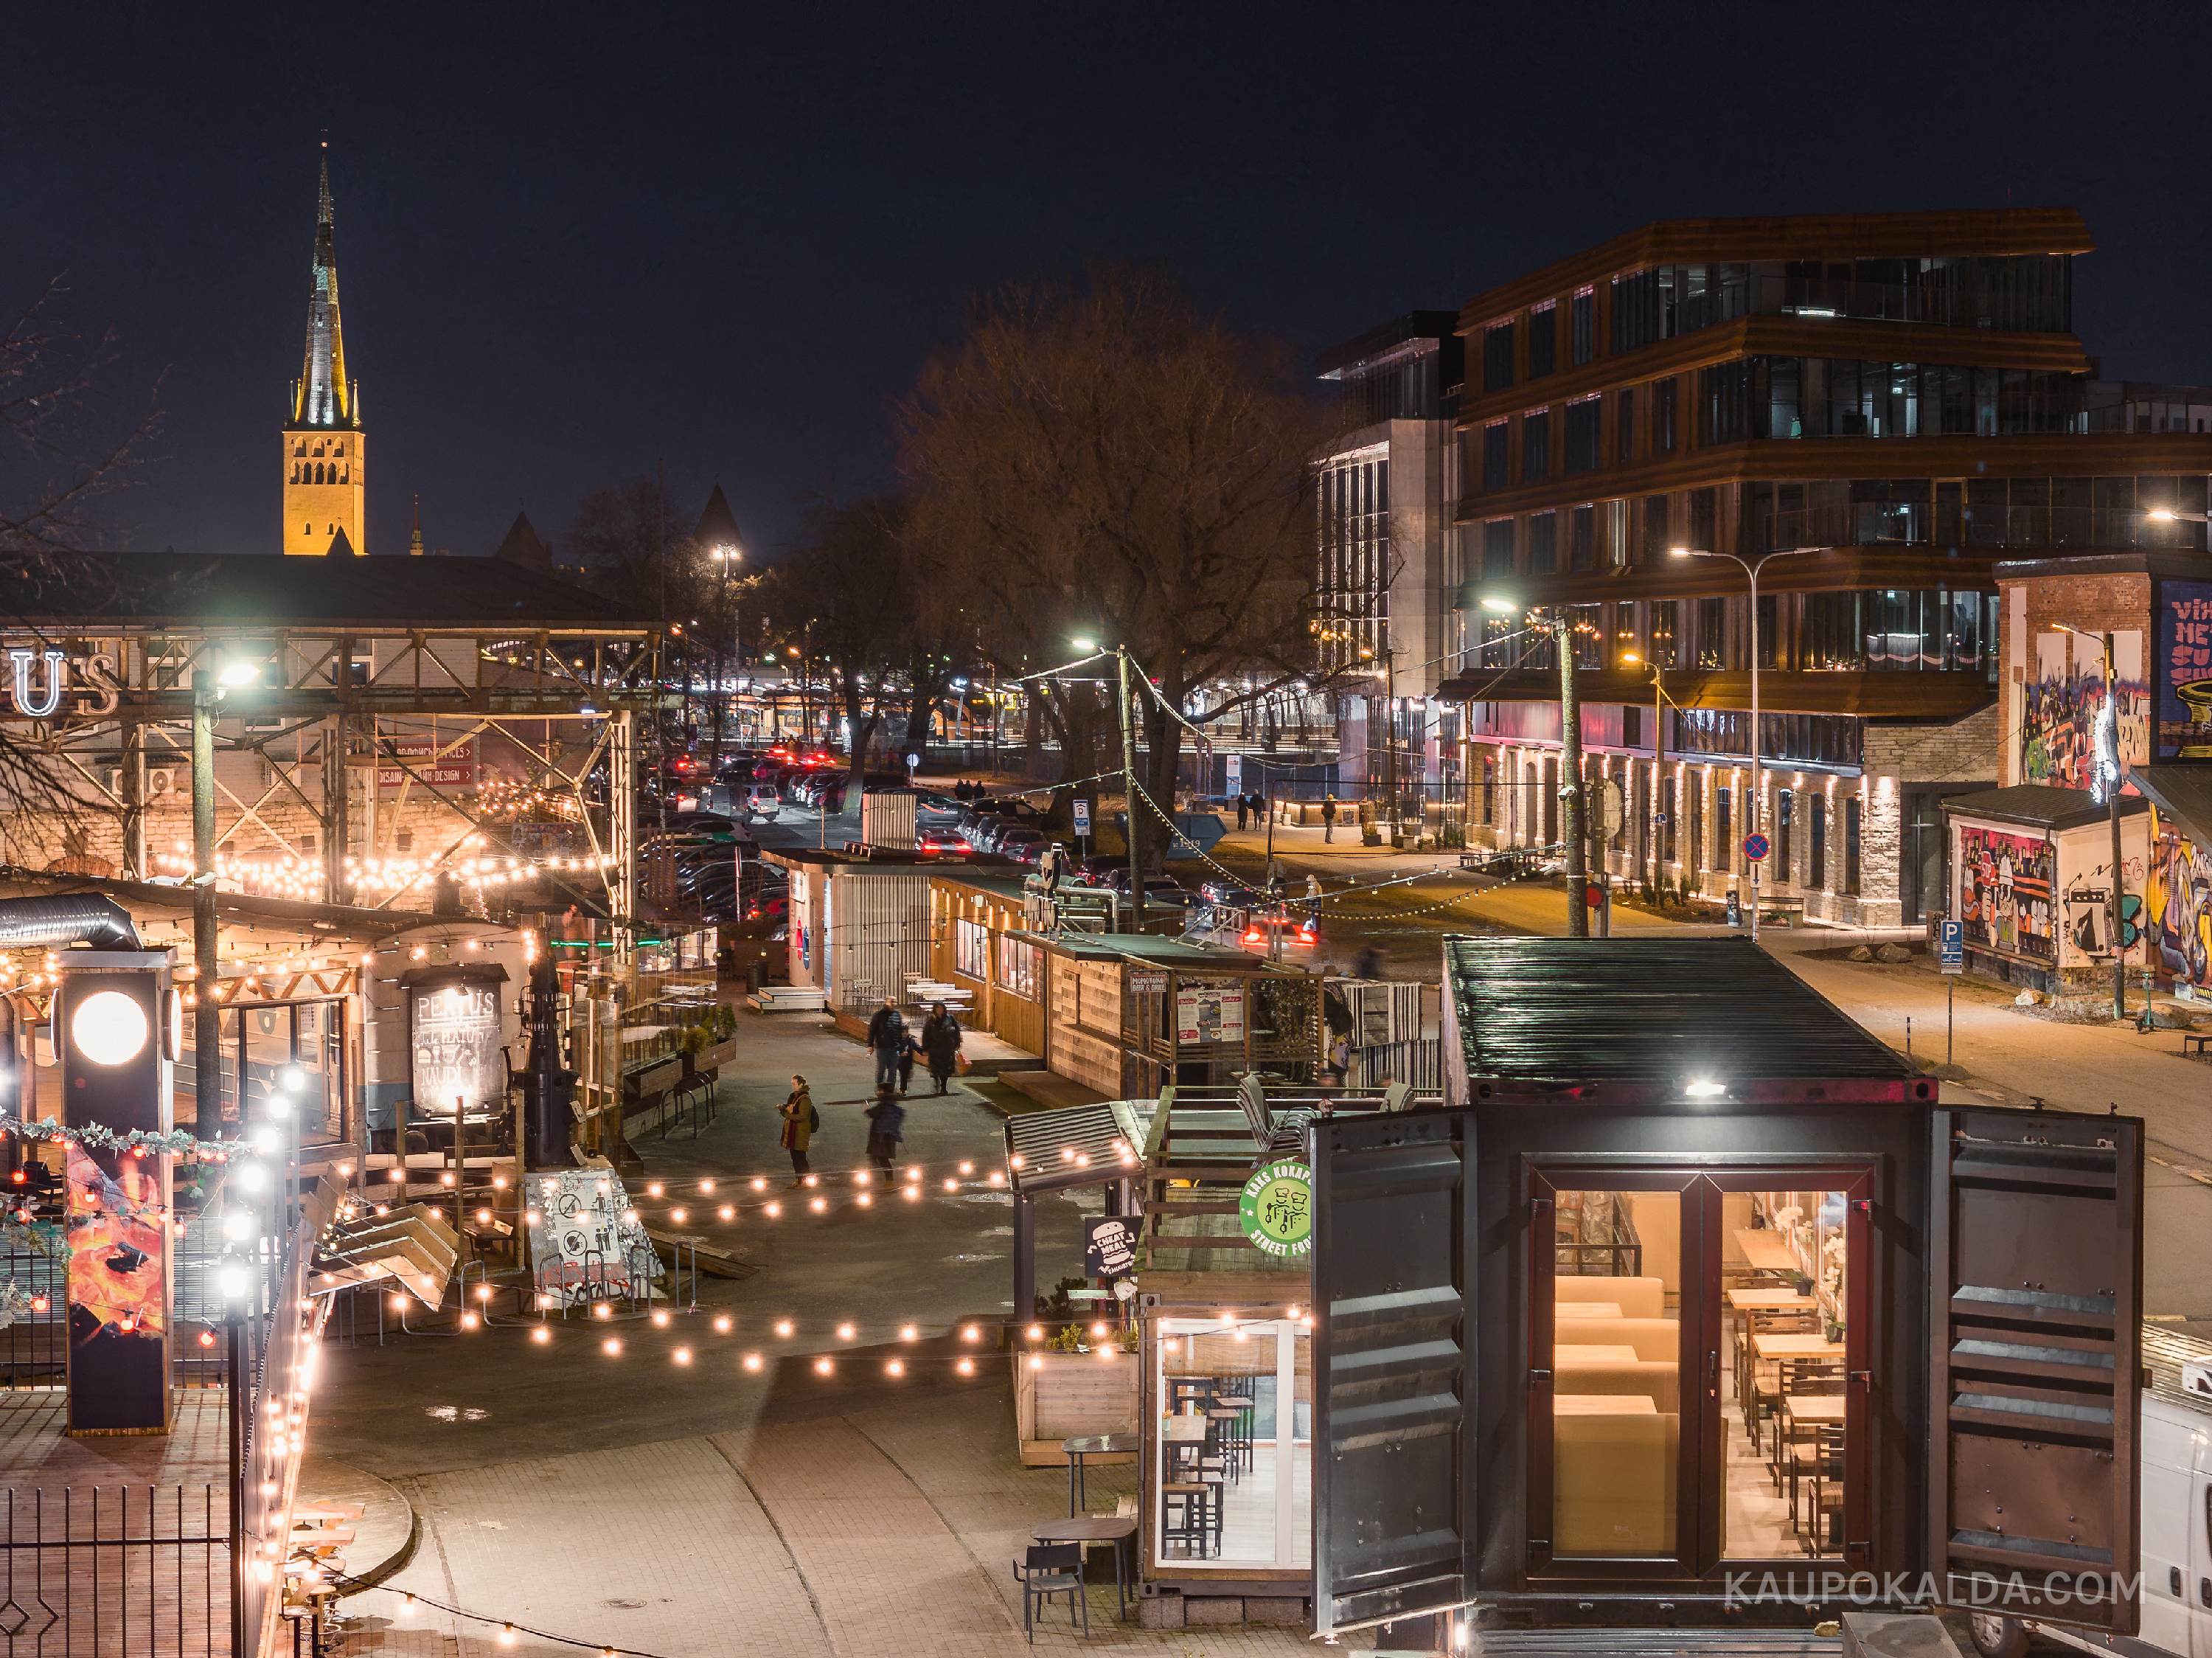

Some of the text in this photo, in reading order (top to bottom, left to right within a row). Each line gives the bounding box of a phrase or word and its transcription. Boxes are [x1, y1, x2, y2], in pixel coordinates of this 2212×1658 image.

[379, 770, 403, 783] DISAIN
[435, 769, 460, 782] DESIGN
[1079, 808, 1084, 816] P
[1947, 924, 1958, 941] P
[1245, 1170, 1272, 1198] KAKS
[1096, 1231, 1125, 1247] CHEAT
[1250, 1229, 1311, 1256] STREET FOO
[1100, 1241, 1127, 1255] MEAL
